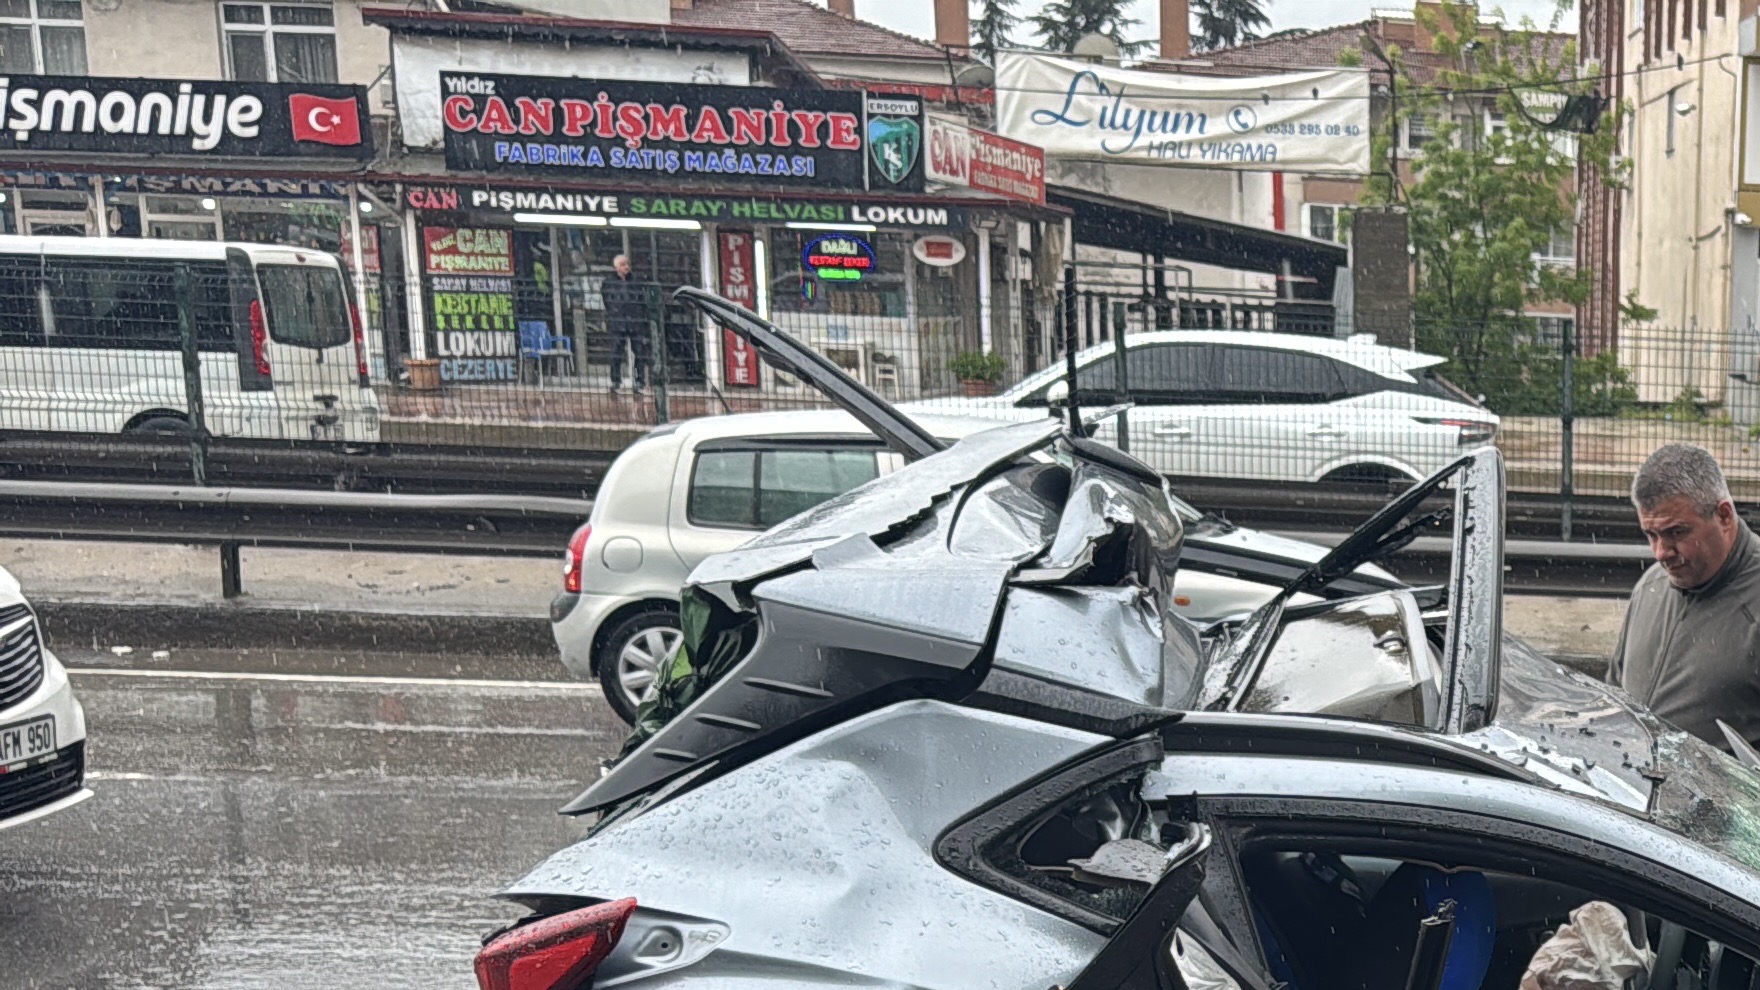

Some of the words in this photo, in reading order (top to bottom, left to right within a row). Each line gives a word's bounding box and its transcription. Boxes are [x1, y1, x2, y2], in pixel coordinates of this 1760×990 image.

[444, 76, 495, 95] Yıldız
[444, 95, 555, 135] CAN
[560, 91, 860, 150] PİŞMANİYE
[1031, 70, 1208, 154] Lilyum
[610, 147, 681, 174] SATIŞ
[684, 149, 815, 178] MAĞAZASI
[1200, 142, 1278, 163] YIKAMA
[408, 187, 458, 210] CAN
[472, 189, 619, 213] PİŞMANİYE
[630, 196, 726, 216] SARAY
[732, 201, 844, 222] HELVASI
[851, 204, 948, 226] LOKUM
[456, 228, 509, 254] CAN
[437, 330, 516, 356] LOKUM
[0, 729, 23, 761] FM
[27, 722, 51, 754] 950
